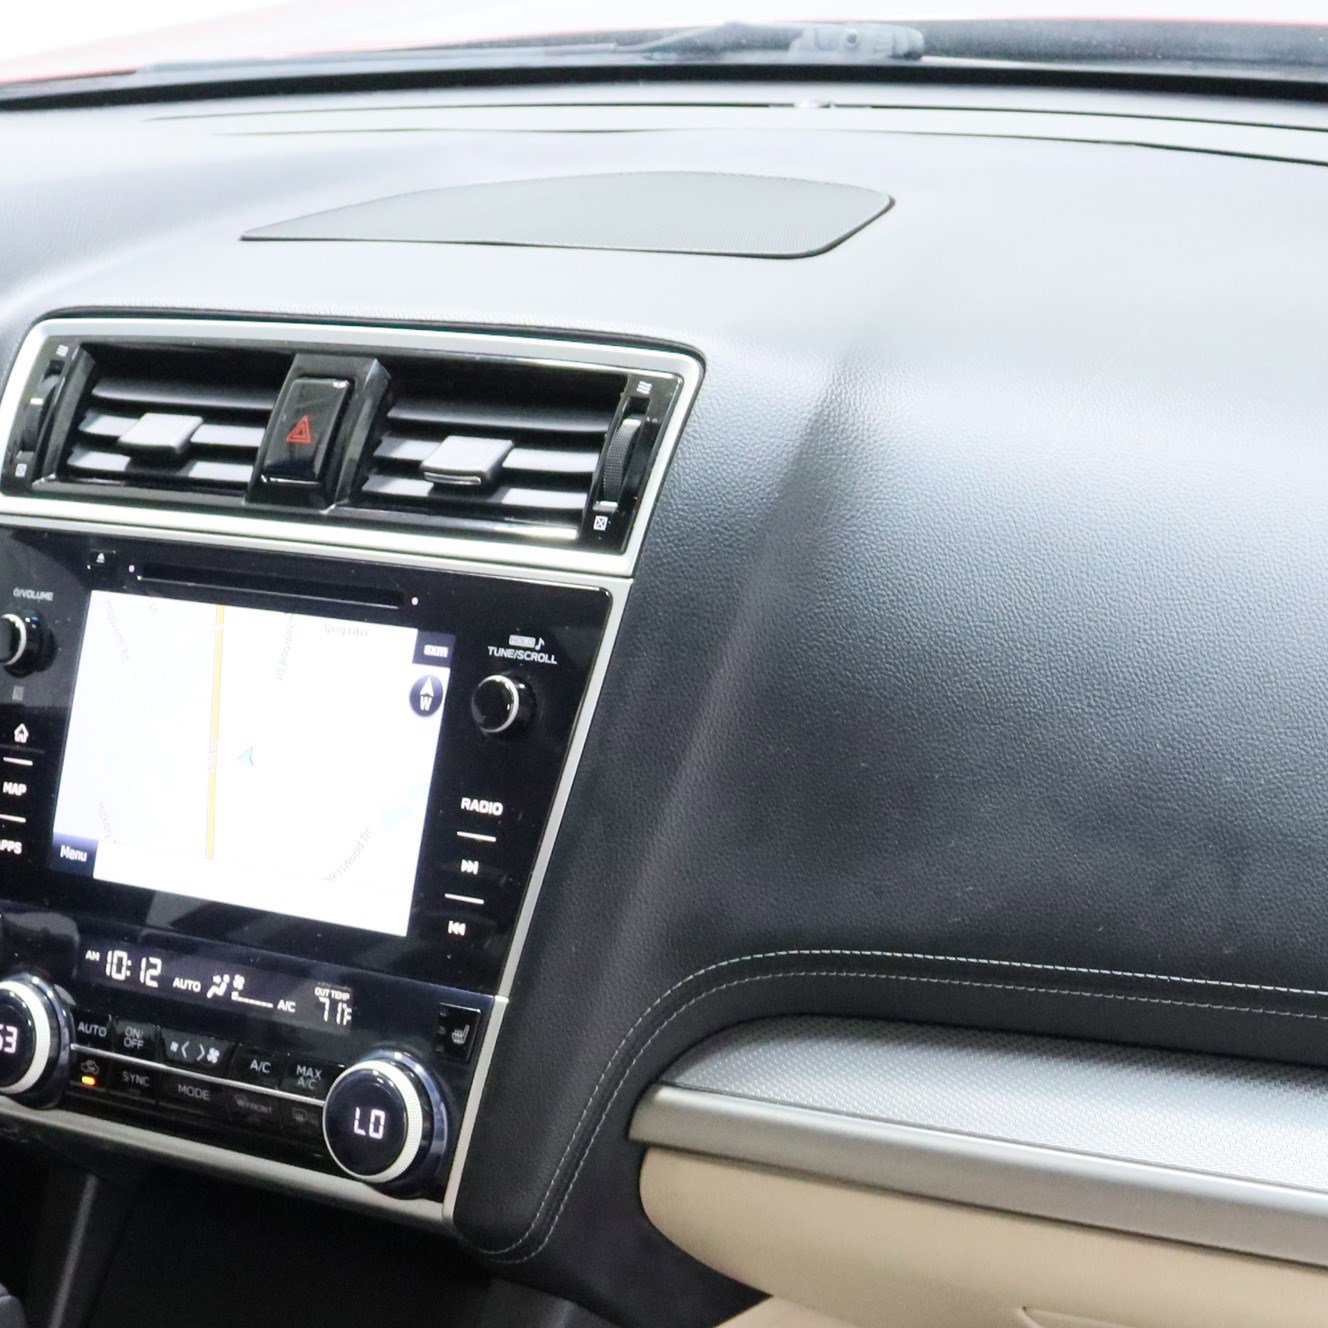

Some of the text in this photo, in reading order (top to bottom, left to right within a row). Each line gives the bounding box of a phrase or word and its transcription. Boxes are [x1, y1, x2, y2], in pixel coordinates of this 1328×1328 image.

[488, 646, 558, 665] TUNE/SCROLL
[419, 695, 432, 711] W
[2, 781, 27, 796] MAP
[461, 797, 504, 816] RADIO
[60, 845, 87, 862] Menu
[85, 949, 162, 988] AM 10:12
[172, 977, 202, 993] AUTO
[314, 986, 330, 997] OUT
[277, 1000, 296, 1012] A/C
[77, 1021, 107, 1038] AUTO
[123, 1036, 144, 1050] OFF
[249, 1059, 272, 1074] A/C
[296, 1064, 322, 1080] MAX
[122, 1071, 150, 1087] SYNC
[296, 1076, 319, 1090] A/C
[177, 1083, 211, 1101] MODE
